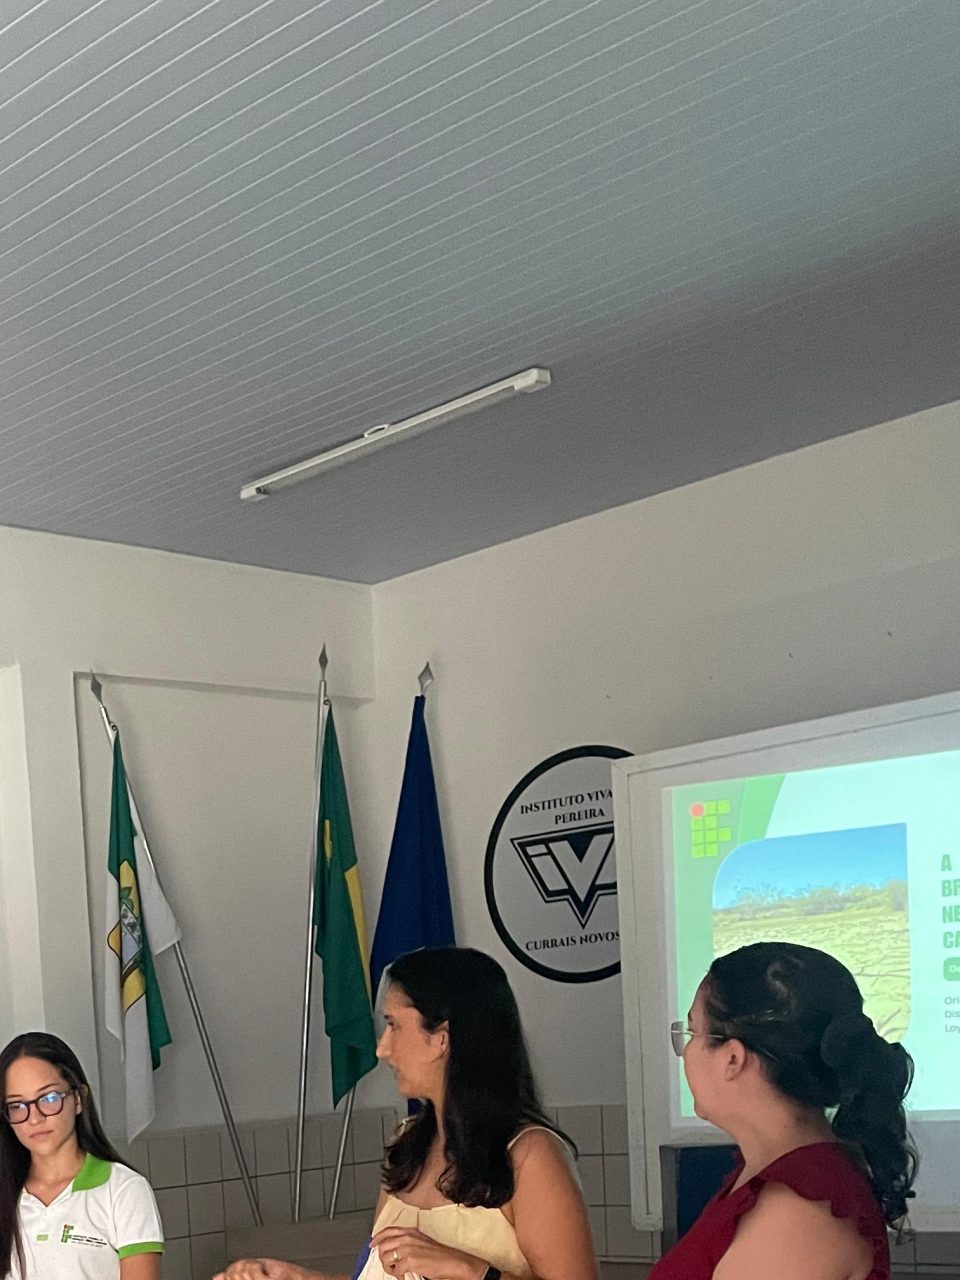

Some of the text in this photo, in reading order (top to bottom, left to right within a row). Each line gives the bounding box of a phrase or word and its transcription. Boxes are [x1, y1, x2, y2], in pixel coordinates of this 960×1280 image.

[520, 793, 585, 815] INSTITUTO
[554, 808, 605, 825] PEREIRA
[941, 854, 952, 871] A
[525, 935, 577, 951] CURRAIS
